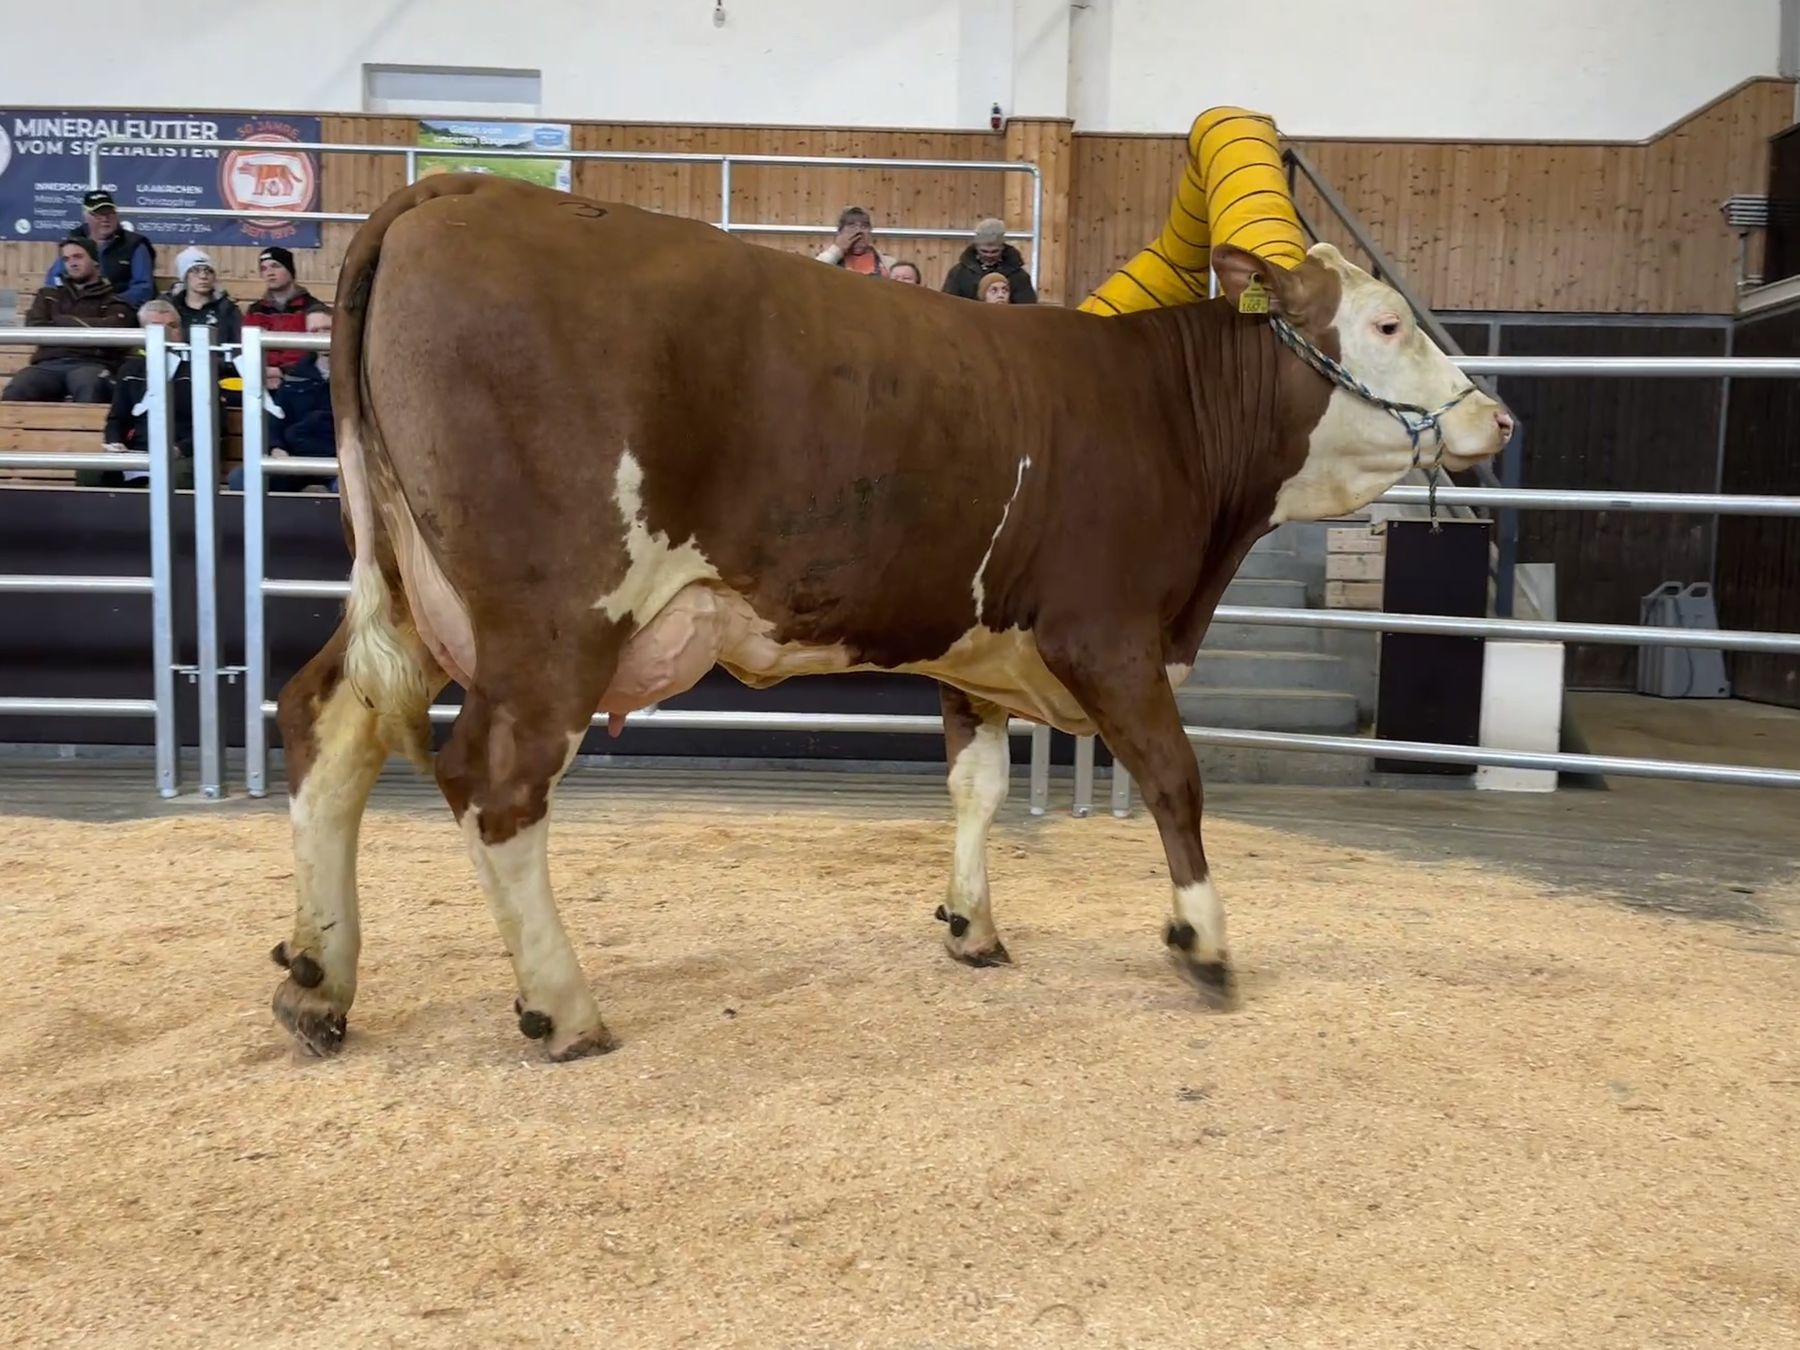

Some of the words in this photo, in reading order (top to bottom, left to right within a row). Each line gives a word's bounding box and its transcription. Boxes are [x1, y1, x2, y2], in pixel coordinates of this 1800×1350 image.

[14, 118, 219, 140] MINERALFUTTER
[14, 140, 64, 155] VOM
[70, 141, 219, 158] SPEZIALISTEN
[34, 182, 118, 192] INNERSCHND
